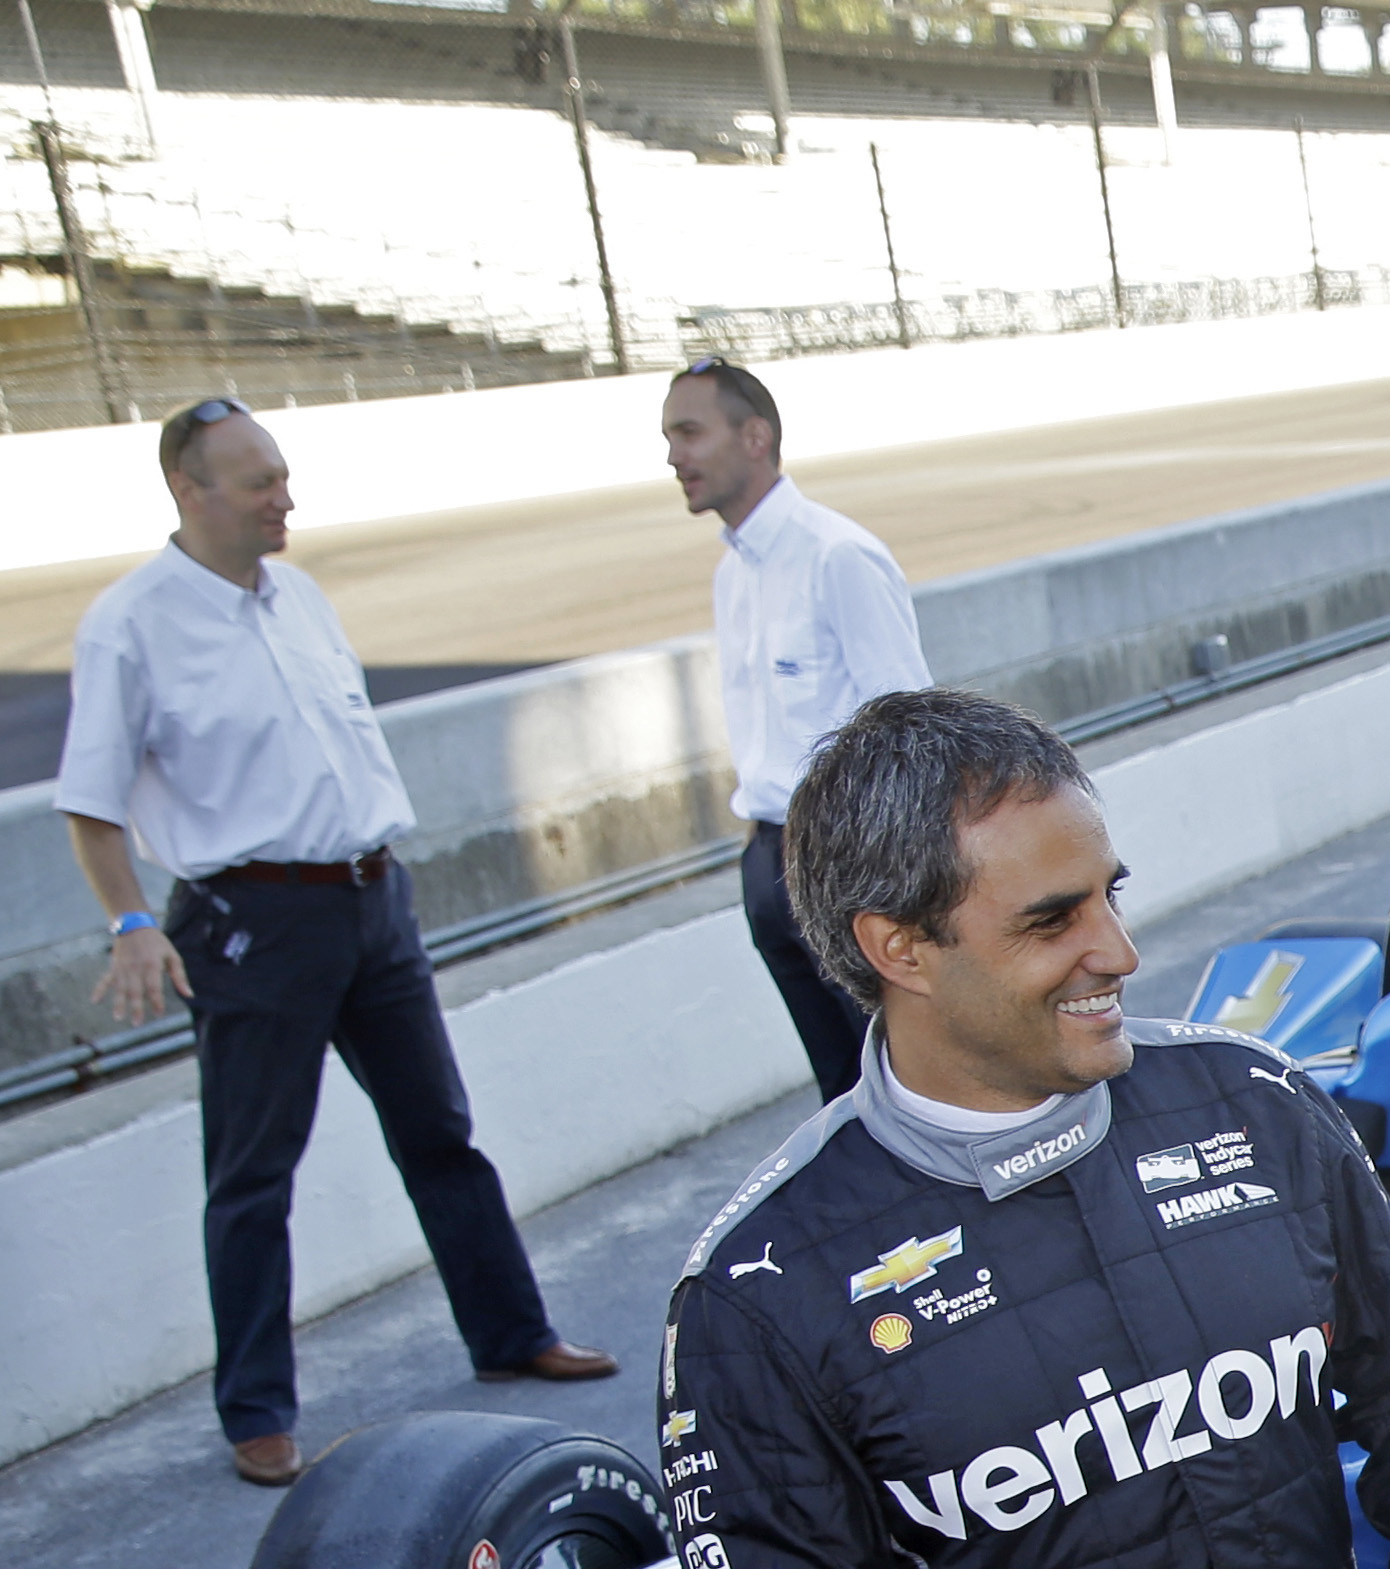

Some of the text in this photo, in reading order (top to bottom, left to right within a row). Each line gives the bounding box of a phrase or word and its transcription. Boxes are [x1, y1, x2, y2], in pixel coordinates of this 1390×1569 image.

[994, 1121, 1087, 1181] verizon
[1194, 1130, 1247, 1152] verizon
[1201, 1143, 1254, 1165] indycar
[1210, 1156, 1254, 1177] series
[1156, 1183, 1247, 1224] HAWK
[913, 1288, 943, 1310] Shell
[918, 1283, 993, 1321] V-Power
[883, 1326, 1328, 1540] verizon
[674, 1485, 716, 1533] PTC
